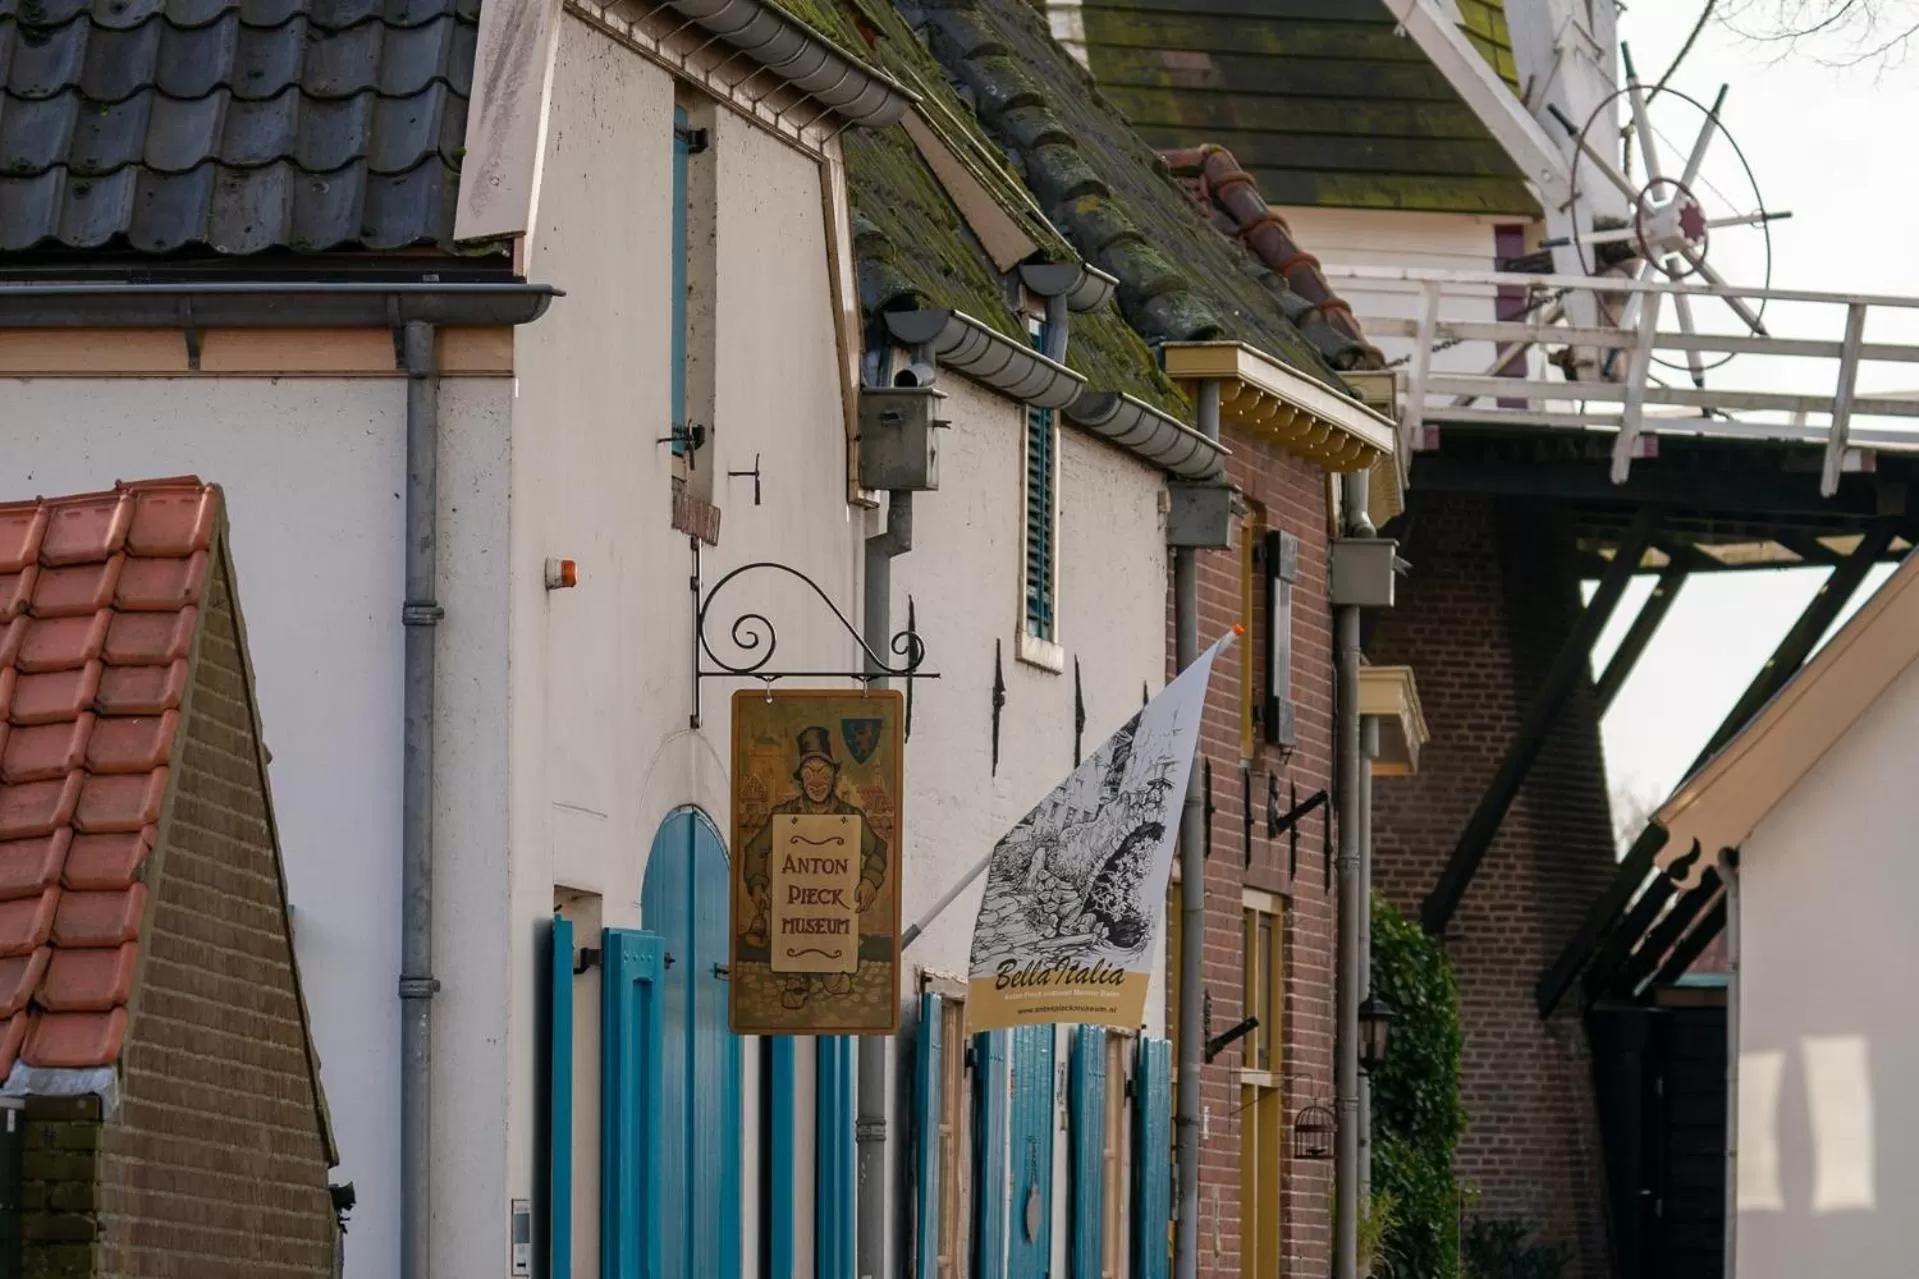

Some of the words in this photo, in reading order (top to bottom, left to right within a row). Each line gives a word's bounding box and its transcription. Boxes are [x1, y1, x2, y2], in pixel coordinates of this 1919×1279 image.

[782, 853, 849, 875] ANTON
[787, 884, 851, 910] PIECK
[780, 917, 851, 935] MUSEUM
[995, 957, 1051, 991] Bella
[1050, 956, 1127, 987] Italia
